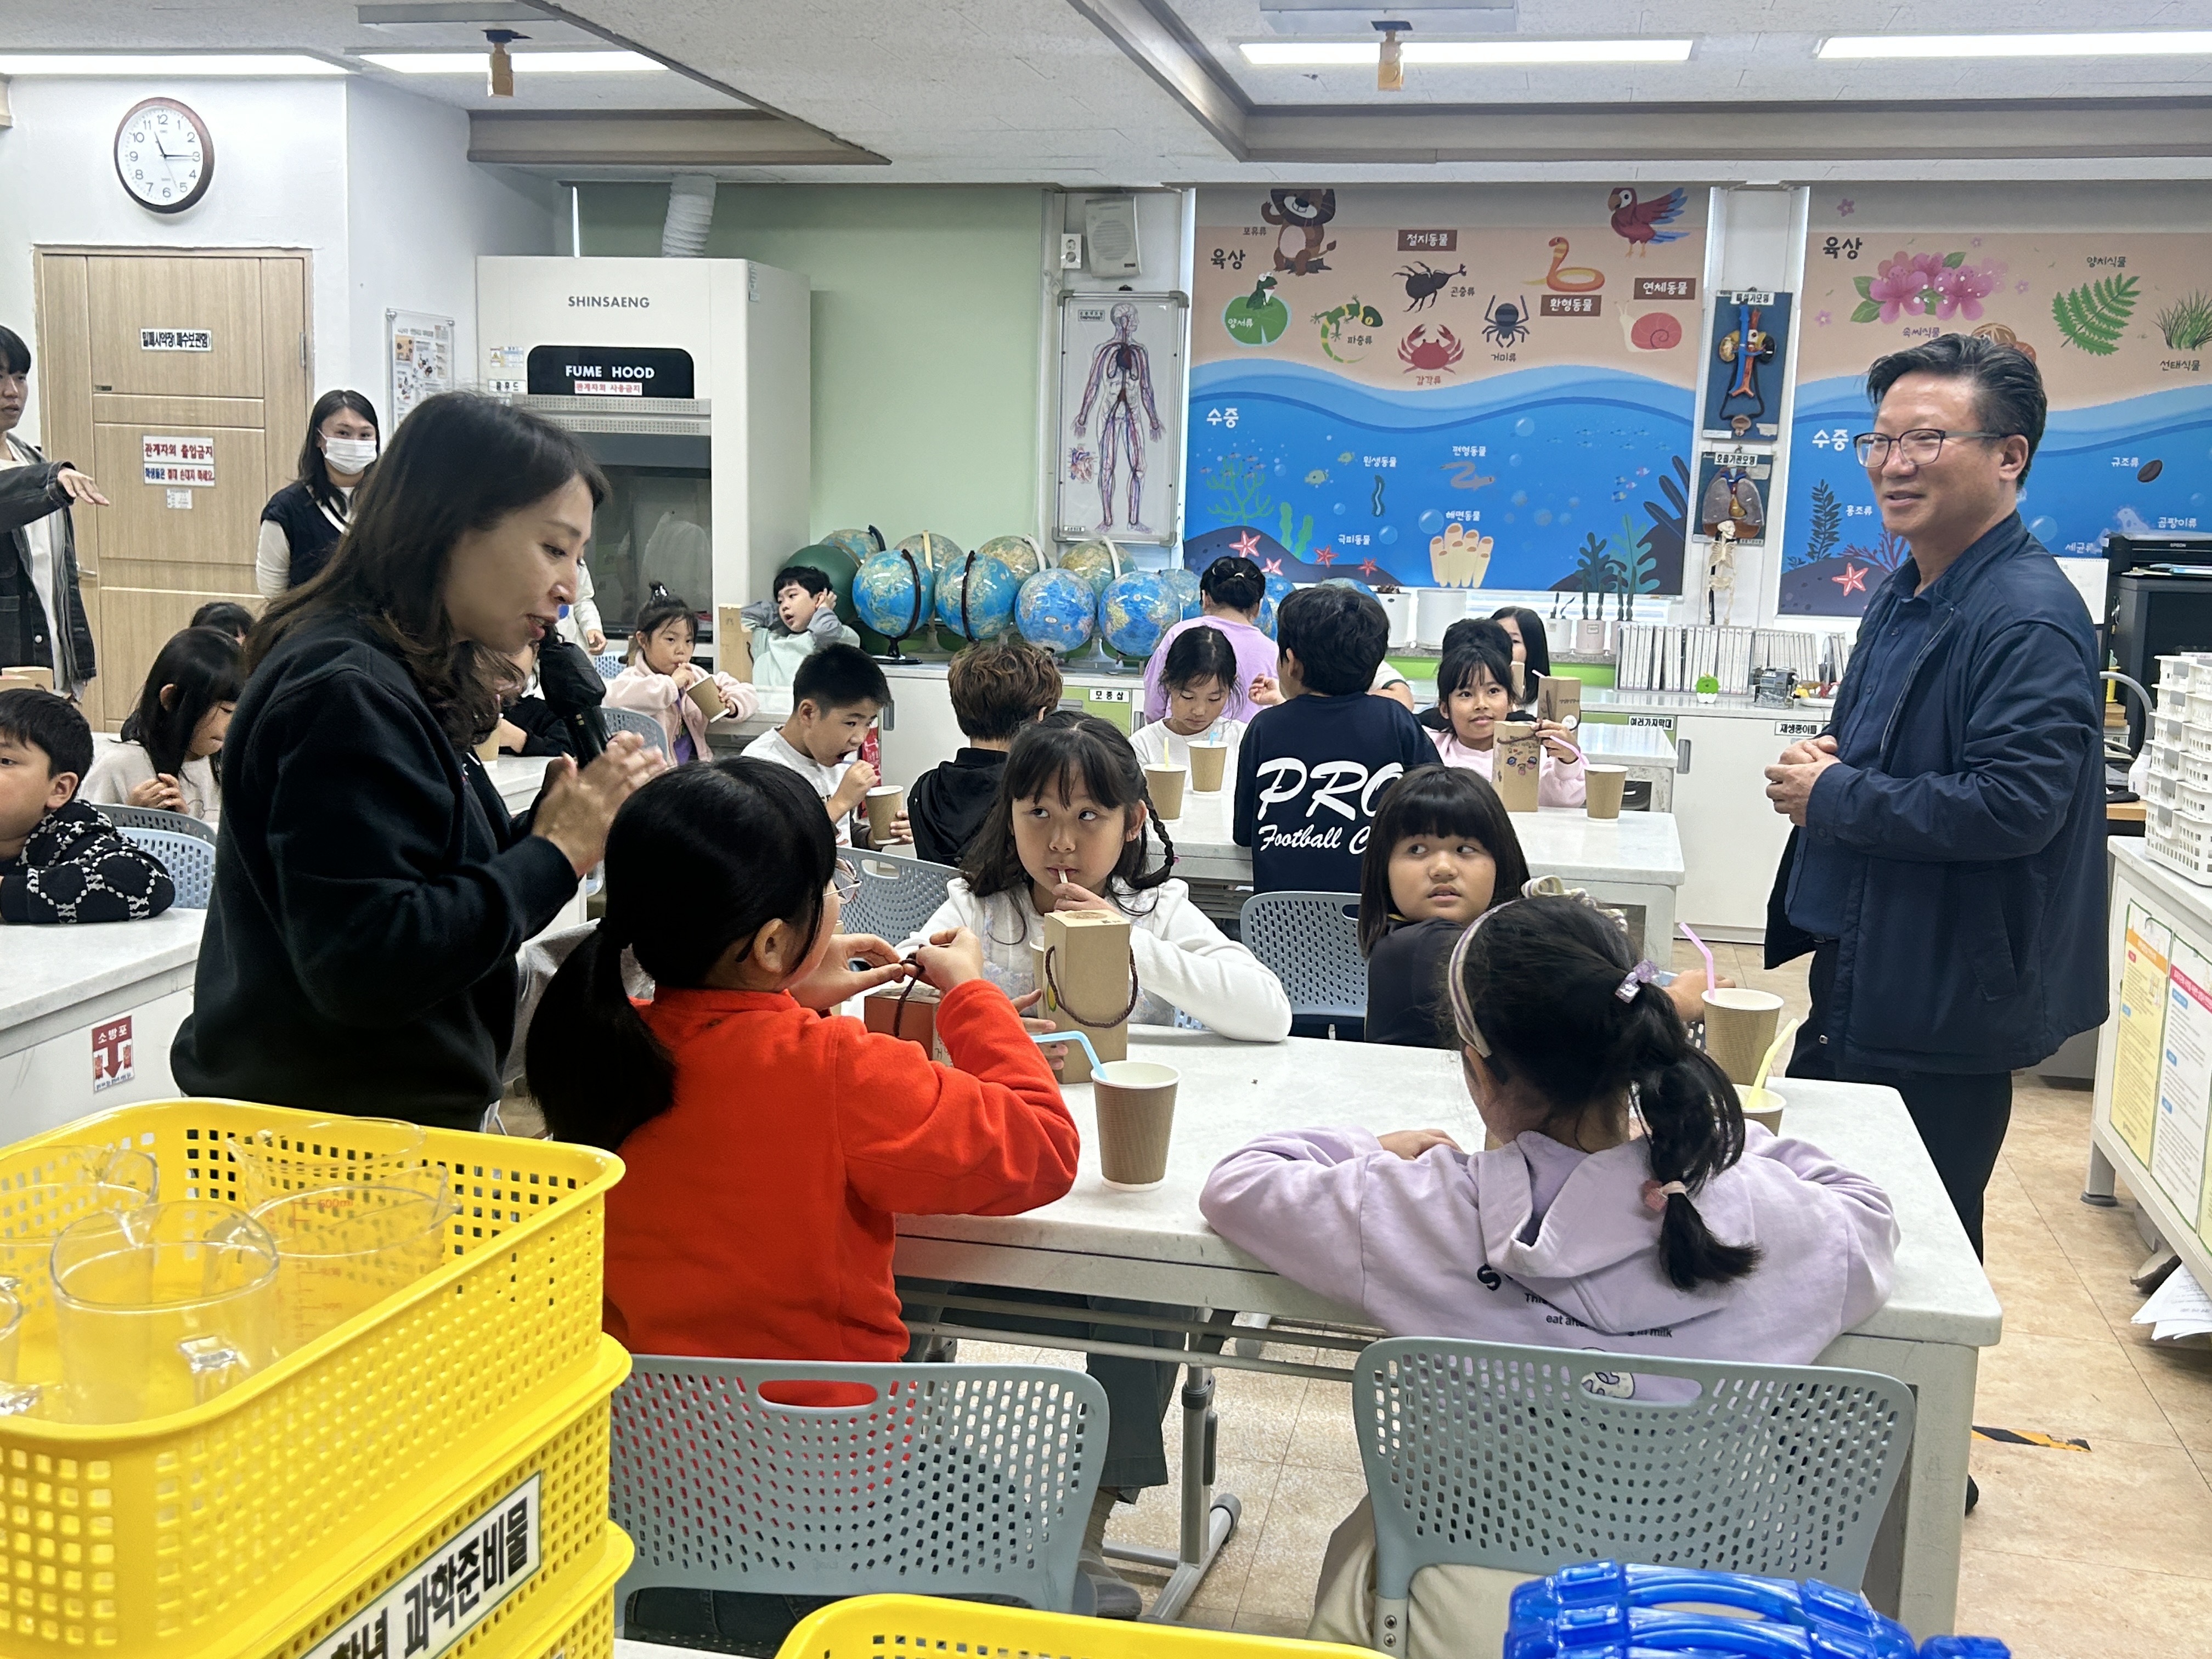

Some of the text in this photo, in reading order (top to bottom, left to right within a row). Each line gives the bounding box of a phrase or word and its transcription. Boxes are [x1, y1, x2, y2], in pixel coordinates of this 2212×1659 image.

[143, 120, 151, 130] 11
[157, 114, 168, 125] 12
[177, 120, 181, 130] 1
[133, 132, 145, 143] 10
[187, 132, 195, 143] 2
[129, 151, 138, 161] 9
[192, 151, 200, 162] 3
[135, 169, 144, 180] 8
[189, 169, 196, 179] 4
[145, 182, 154, 193] 7
[162, 187, 171, 198] 6
[179, 182, 188, 193] 5
[1243, 227, 1267, 236] 포유류
[1407, 233, 1448, 247] 절지동물
[1822, 236, 1863, 259] 육상
[1211, 249, 1246, 270] 육상
[2086, 256, 2126, 268] 양치식물
[1450, 286, 1475, 297] 곤충류
[1643, 281, 1688, 296] 연체동물
[568, 296, 650, 308] SHINSAENG
[1550, 298, 1593, 313] 환형동물
[1228, 318, 1254, 329] 양서류
[1903, 327, 1940, 338] 속씨식물
[1347, 335, 1373, 346] 파충류
[1491, 352, 1517, 363] 거미류
[2160, 360, 2200, 371] 선태식물
[566, 365, 655, 379] FUME HOOD
[1416, 375, 1441, 386] 갑각류
[576, 383, 640, 394] 관계자외 사용금지
[1206, 408, 1239, 428] 수중
[1812, 429, 1849, 452] 수중
[145, 443, 213, 460] 관계자외 출입금지
[1452, 445, 1486, 457] 편형동물
[1363, 455, 1397, 467] 원생동물
[1716, 454, 1756, 465] 호흡기관모형
[2111, 457, 2139, 467] 규조류
[1446, 510, 1480, 522] 해면동물
[1846, 505, 1872, 517] 홍조류
[2158, 517, 2197, 528] 곰팡이류
[1338, 534, 1370, 545] 극피동물
[1630, 717, 1672, 729] 여러가지막대
[1259, 824, 1343, 851] Football
[98, 1024, 127, 1044] 소방포
[1546, 1314, 1563, 1325] eat
[405, 1496, 528, 1659] 과학준비물
